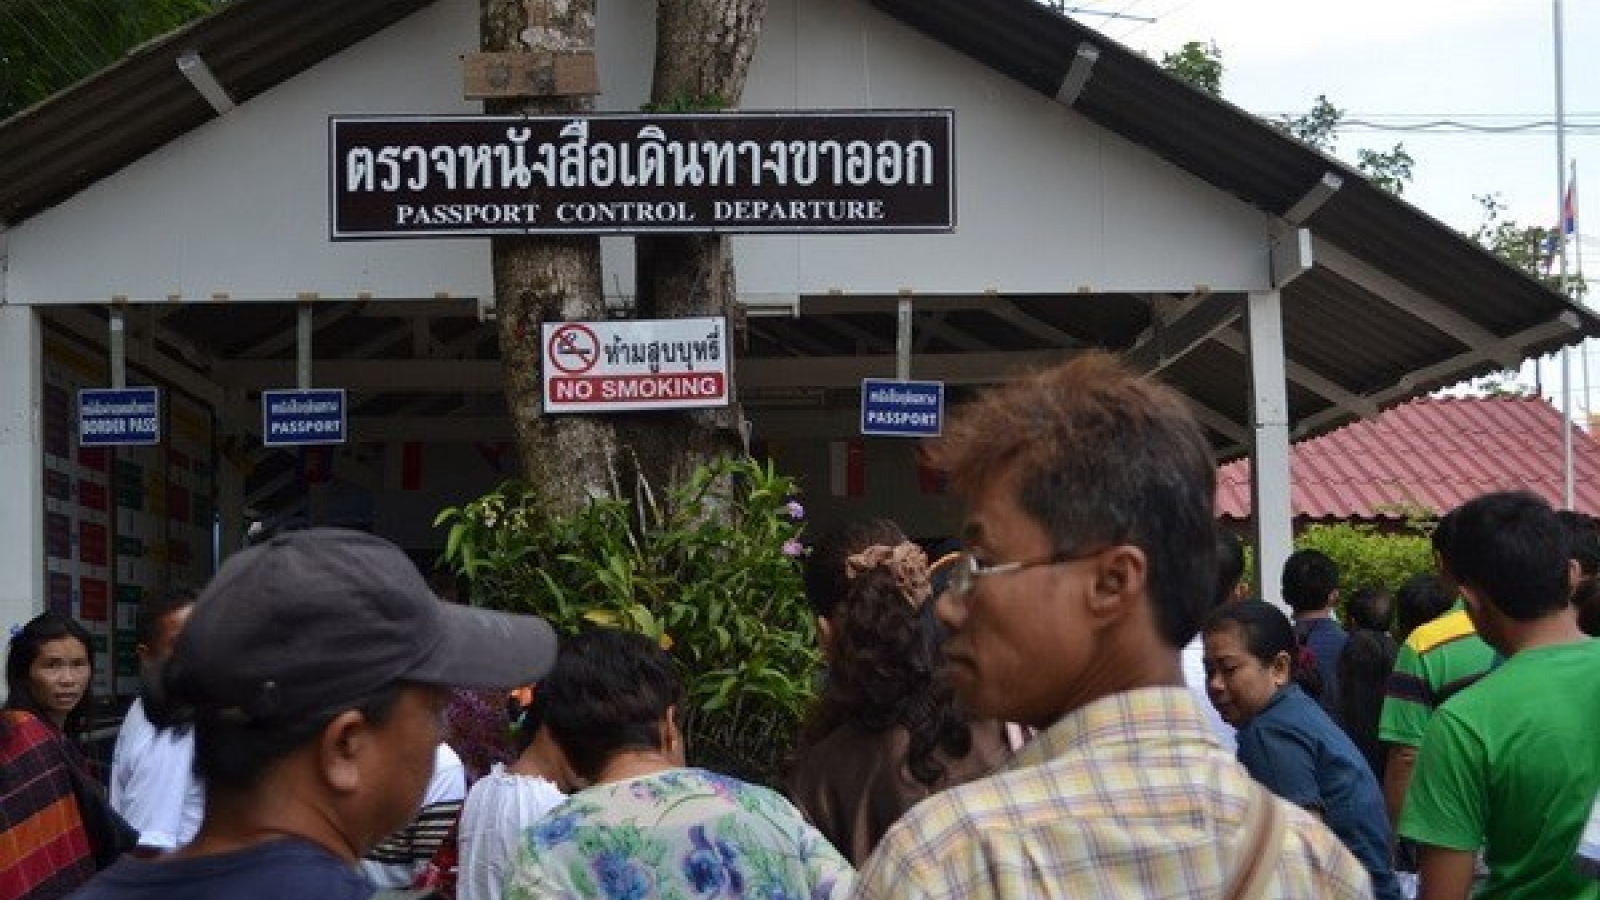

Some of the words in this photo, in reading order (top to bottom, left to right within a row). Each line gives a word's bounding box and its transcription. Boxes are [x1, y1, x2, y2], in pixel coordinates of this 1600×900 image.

[346, 119, 934, 192] ตรวจหนังสือเดินทางขาออก
[397, 204, 541, 225] PASSPORT
[556, 202, 696, 223] CONTROL
[713, 199, 885, 220] DEPARTURE
[604, 325, 720, 374] ห้ามสูบบุหรี่
[556, 381, 593, 399] NO
[602, 377, 717, 398] SMOKING
[82, 418, 126, 434] BORDER
[129, 417, 158, 432] PASS
[271, 420, 341, 434] PASSPORT
[868, 411, 937, 426] PASSPORT
